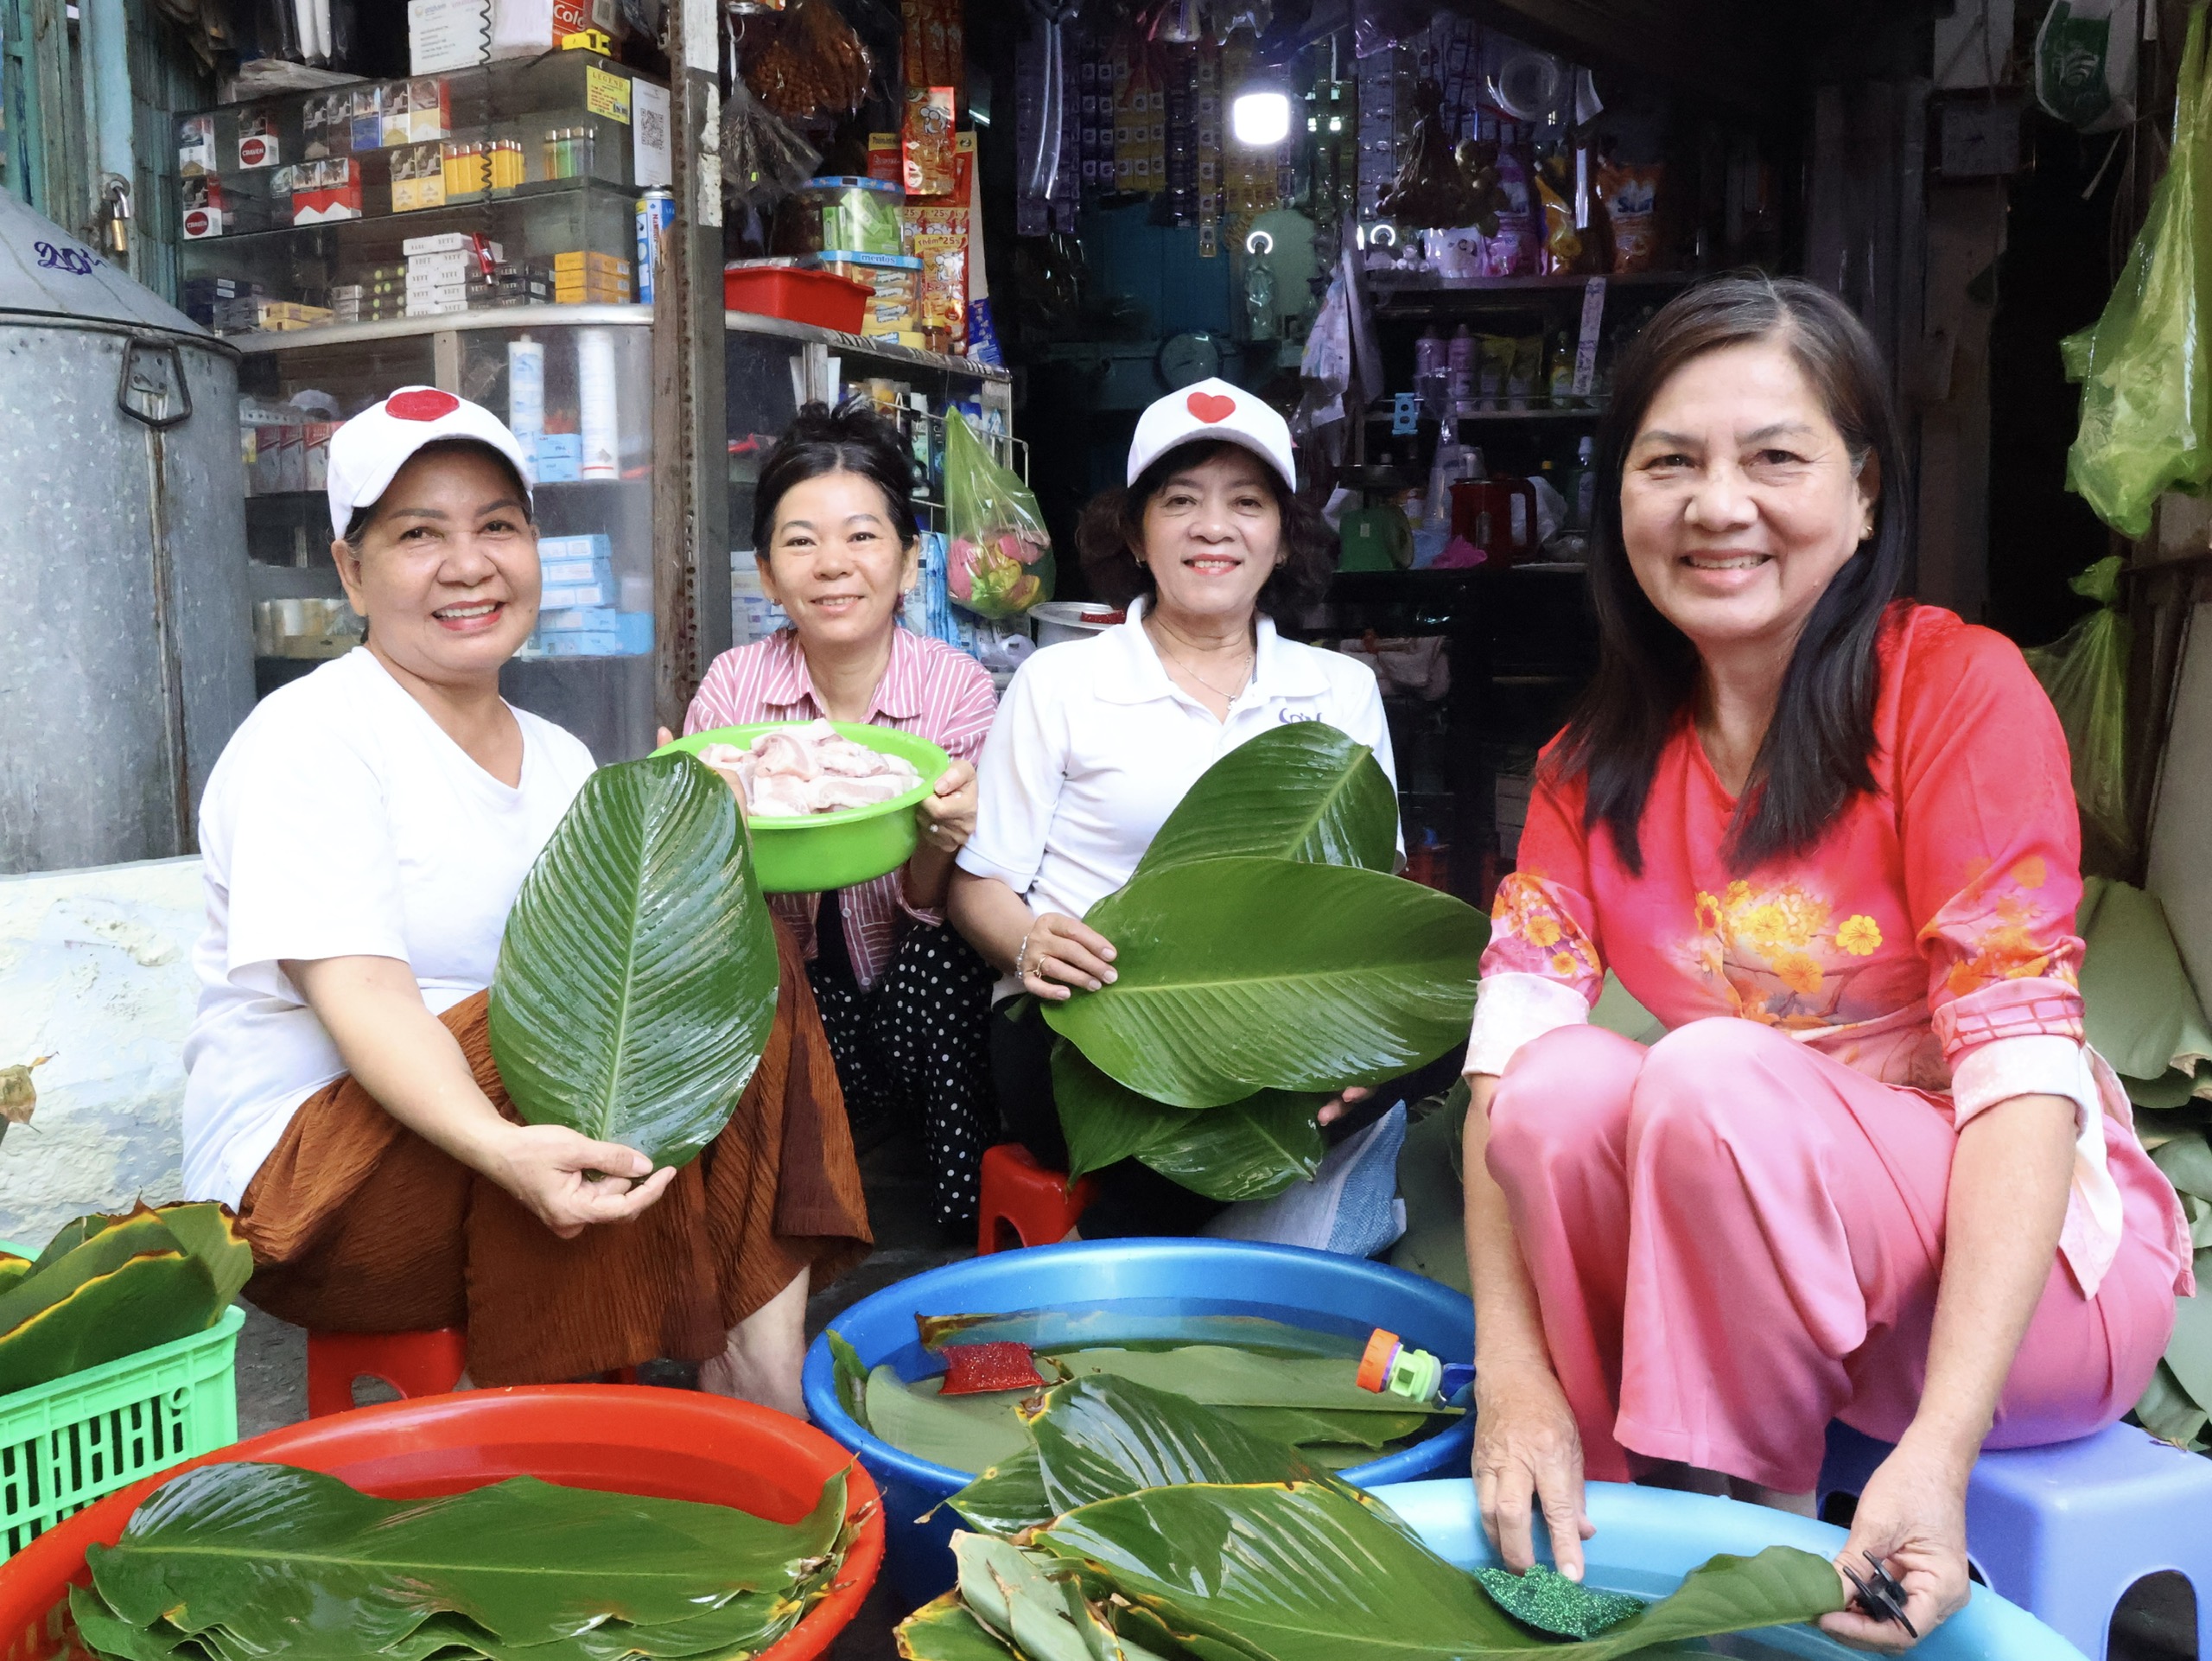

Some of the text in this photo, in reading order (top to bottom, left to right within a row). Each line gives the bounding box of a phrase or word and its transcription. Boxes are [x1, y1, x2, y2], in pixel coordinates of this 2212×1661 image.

[592, 72, 623, 88] LEGEND
[242, 148, 264, 156] CRAVEN
[187, 220, 207, 228] CRAVEN
[861, 254, 895, 264] mentos
